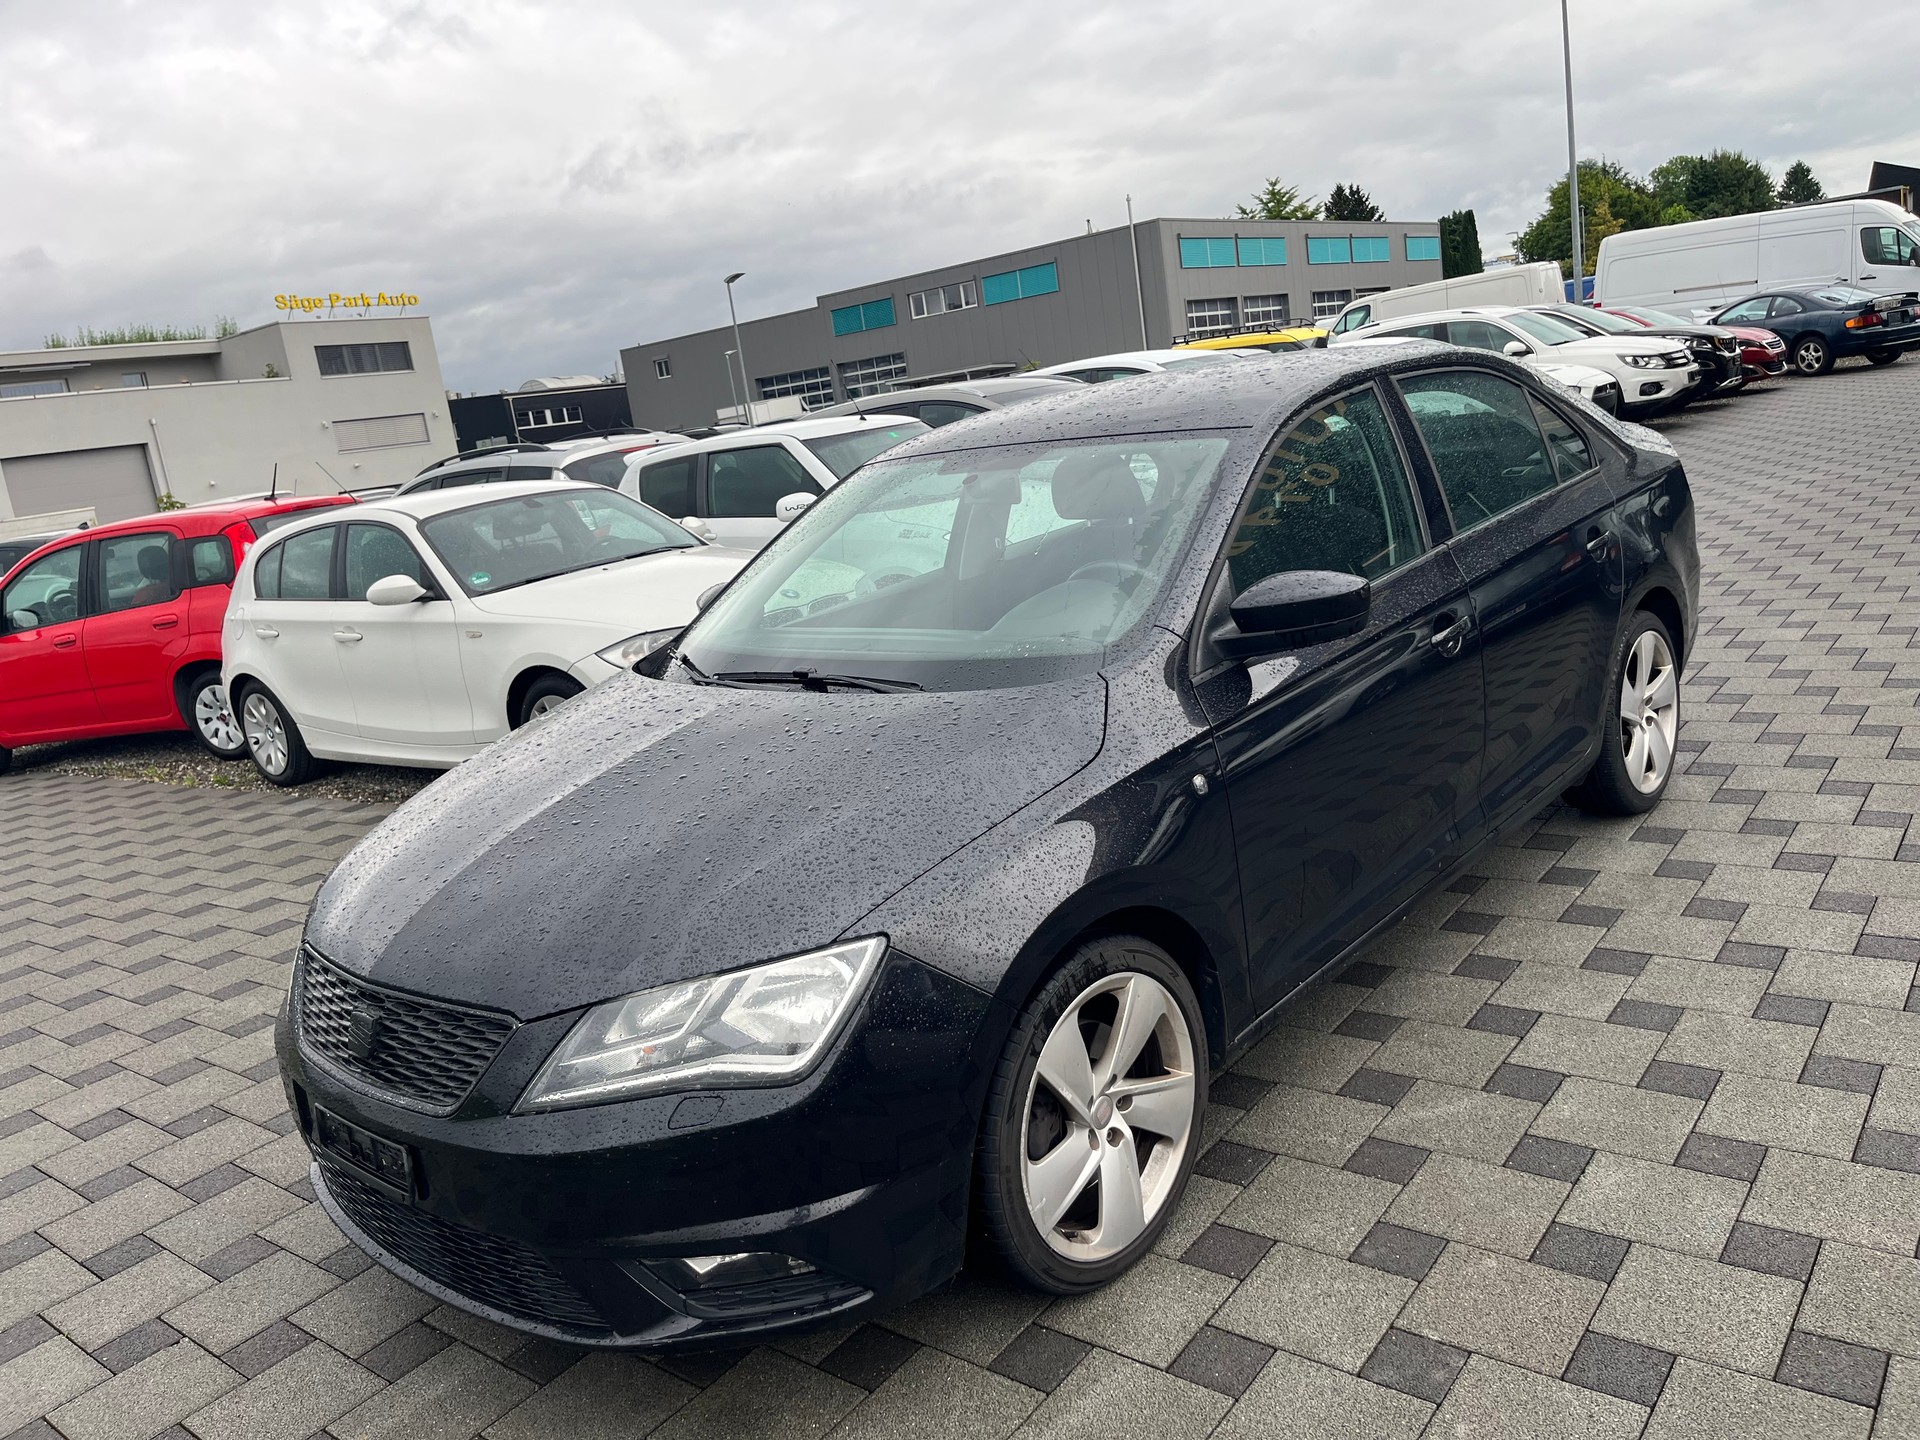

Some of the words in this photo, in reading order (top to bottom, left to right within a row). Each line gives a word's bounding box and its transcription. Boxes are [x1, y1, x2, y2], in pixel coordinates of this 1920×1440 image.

[274, 294, 324, 313] Säge
[329, 292, 372, 308] Park
[377, 292, 419, 306] Auto
